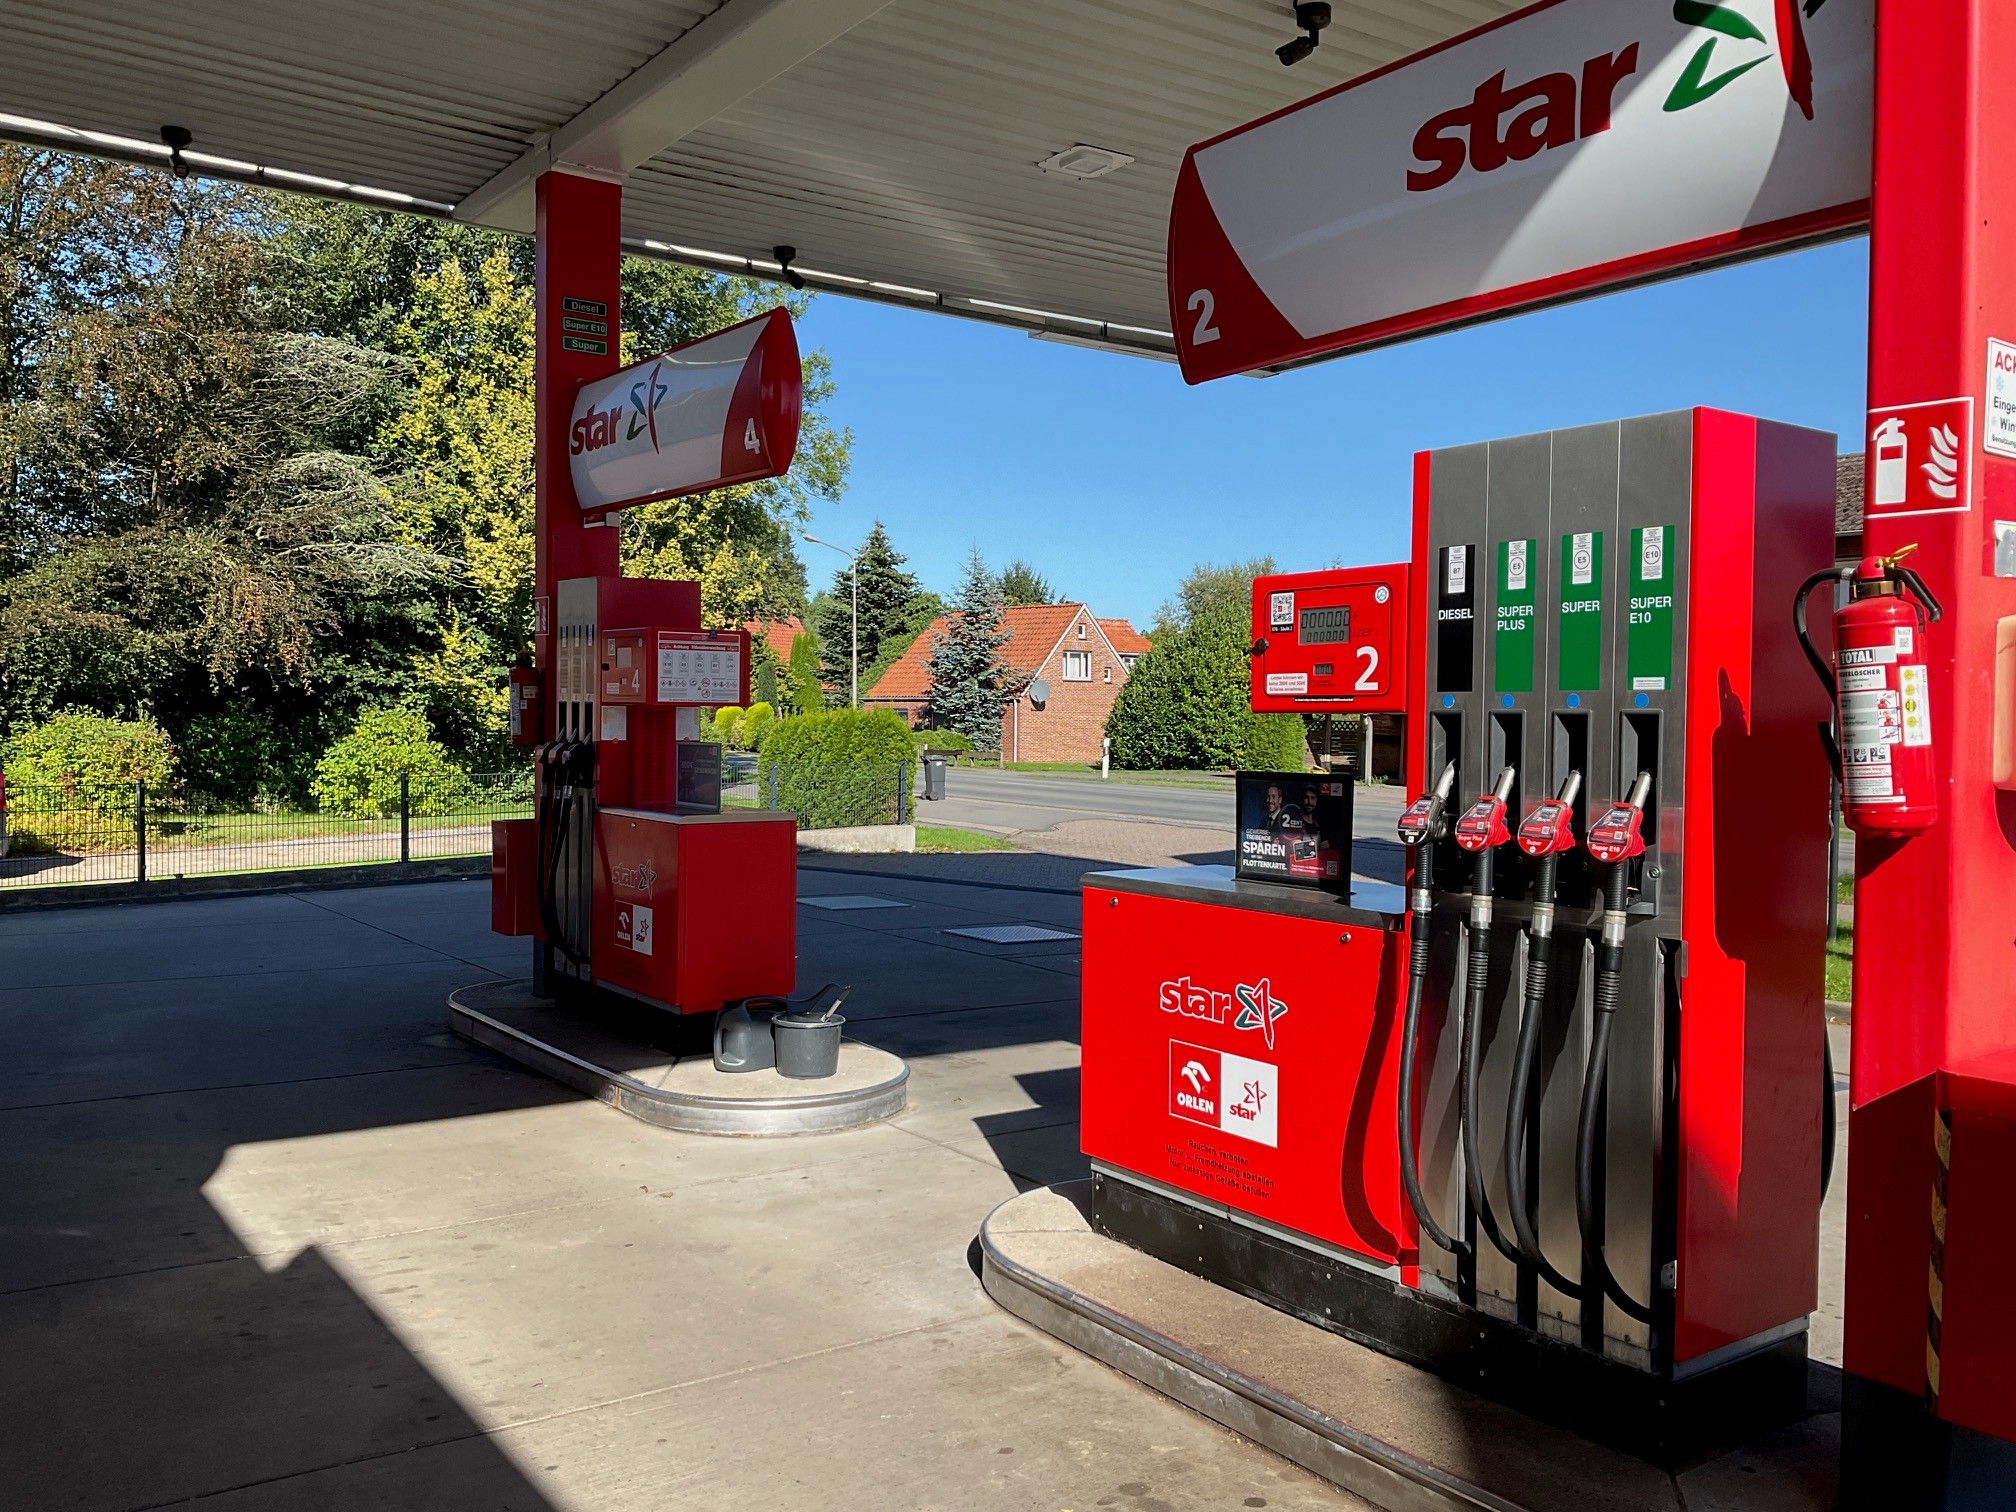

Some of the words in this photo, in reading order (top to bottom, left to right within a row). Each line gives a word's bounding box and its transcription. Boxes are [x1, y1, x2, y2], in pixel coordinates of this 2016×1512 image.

[1406, 41, 1639, 192] star
[571, 301, 599, 314] Diesel
[1187, 289, 1221, 346] 2
[565, 319, 588, 332] Super
[590, 323, 605, 333] E10
[571, 339, 599, 351] Super
[570, 404, 623, 455] star
[2000, 417, 2016, 433] Win
[744, 417, 760, 455] 4
[1577, 556, 1587, 564] E5
[1645, 551, 1659, 559] E10
[1512, 562, 1521, 570] E5
[1561, 600, 1600, 613] SUPER
[1630, 595, 1672, 610] SUPER
[1438, 607, 1474, 621] DIESEL
[1497, 605, 1533, 618] SUPER
[1629, 612, 1651, 624] E10
[1497, 619, 1525, 631] PLUS
[1841, 650, 1873, 664] TOTAL
[1354, 646, 1379, 691] 2
[631, 669, 640, 693] 4
[1282, 813, 1290, 828] 2
[1242, 841, 1286, 857] SPAREN
[1526, 838, 1542, 846] Super
[1591, 843, 1608, 851] Super
[1242, 859, 1287, 870] FLOTTENKARTE.
[612, 862, 638, 888] star
[1160, 976, 1231, 1024] star
[1177, 1092, 1214, 1115] ORLEN
[1229, 1103, 1256, 1121] star
[1188, 1140, 1216, 1156] Rauchen
[1219, 1150, 1249, 1166] verboten
[1165, 1144, 1184, 1157] Motor
[1194, 1154, 1240, 1178] Fremdheizung
[1242, 1170, 1275, 1188] abstellen
[1169, 1158, 1181, 1168] Nur
[1183, 1163, 1213, 1181] zulässige
[1215, 1174, 1240, 1189] Gefäße
[1242, 1183, 1270, 1199] befüllen
